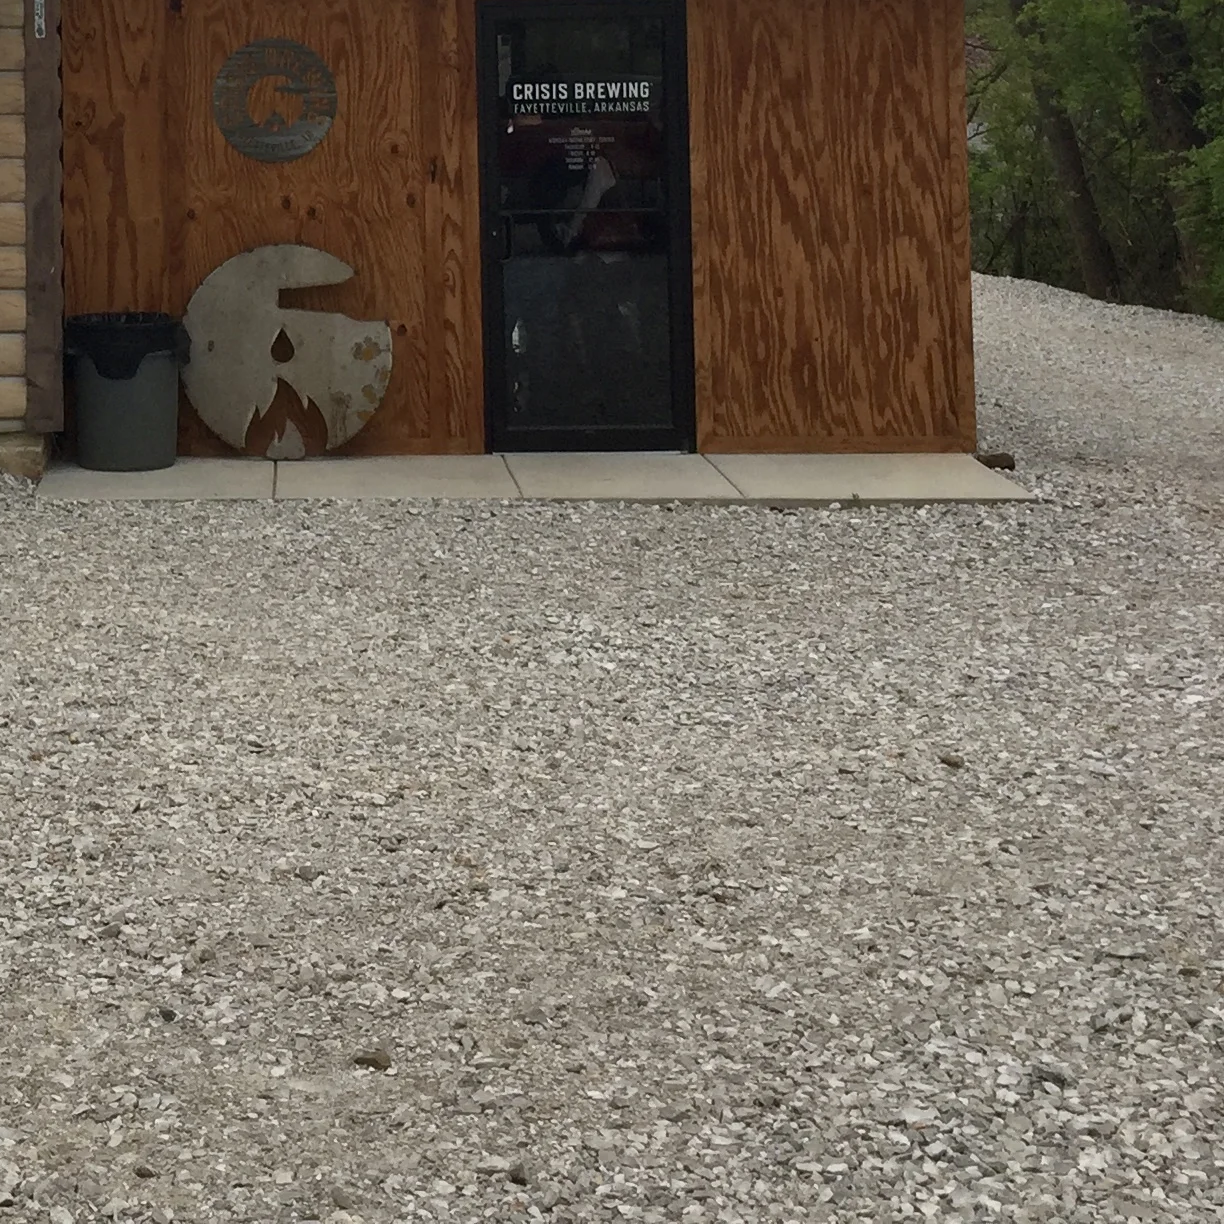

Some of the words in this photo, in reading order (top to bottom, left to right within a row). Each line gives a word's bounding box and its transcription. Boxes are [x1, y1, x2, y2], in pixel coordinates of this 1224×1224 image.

[513, 84, 567, 100] CRISIS
[575, 82, 649, 99] BREWING
[593, 101, 650, 113] ARKANSAS
